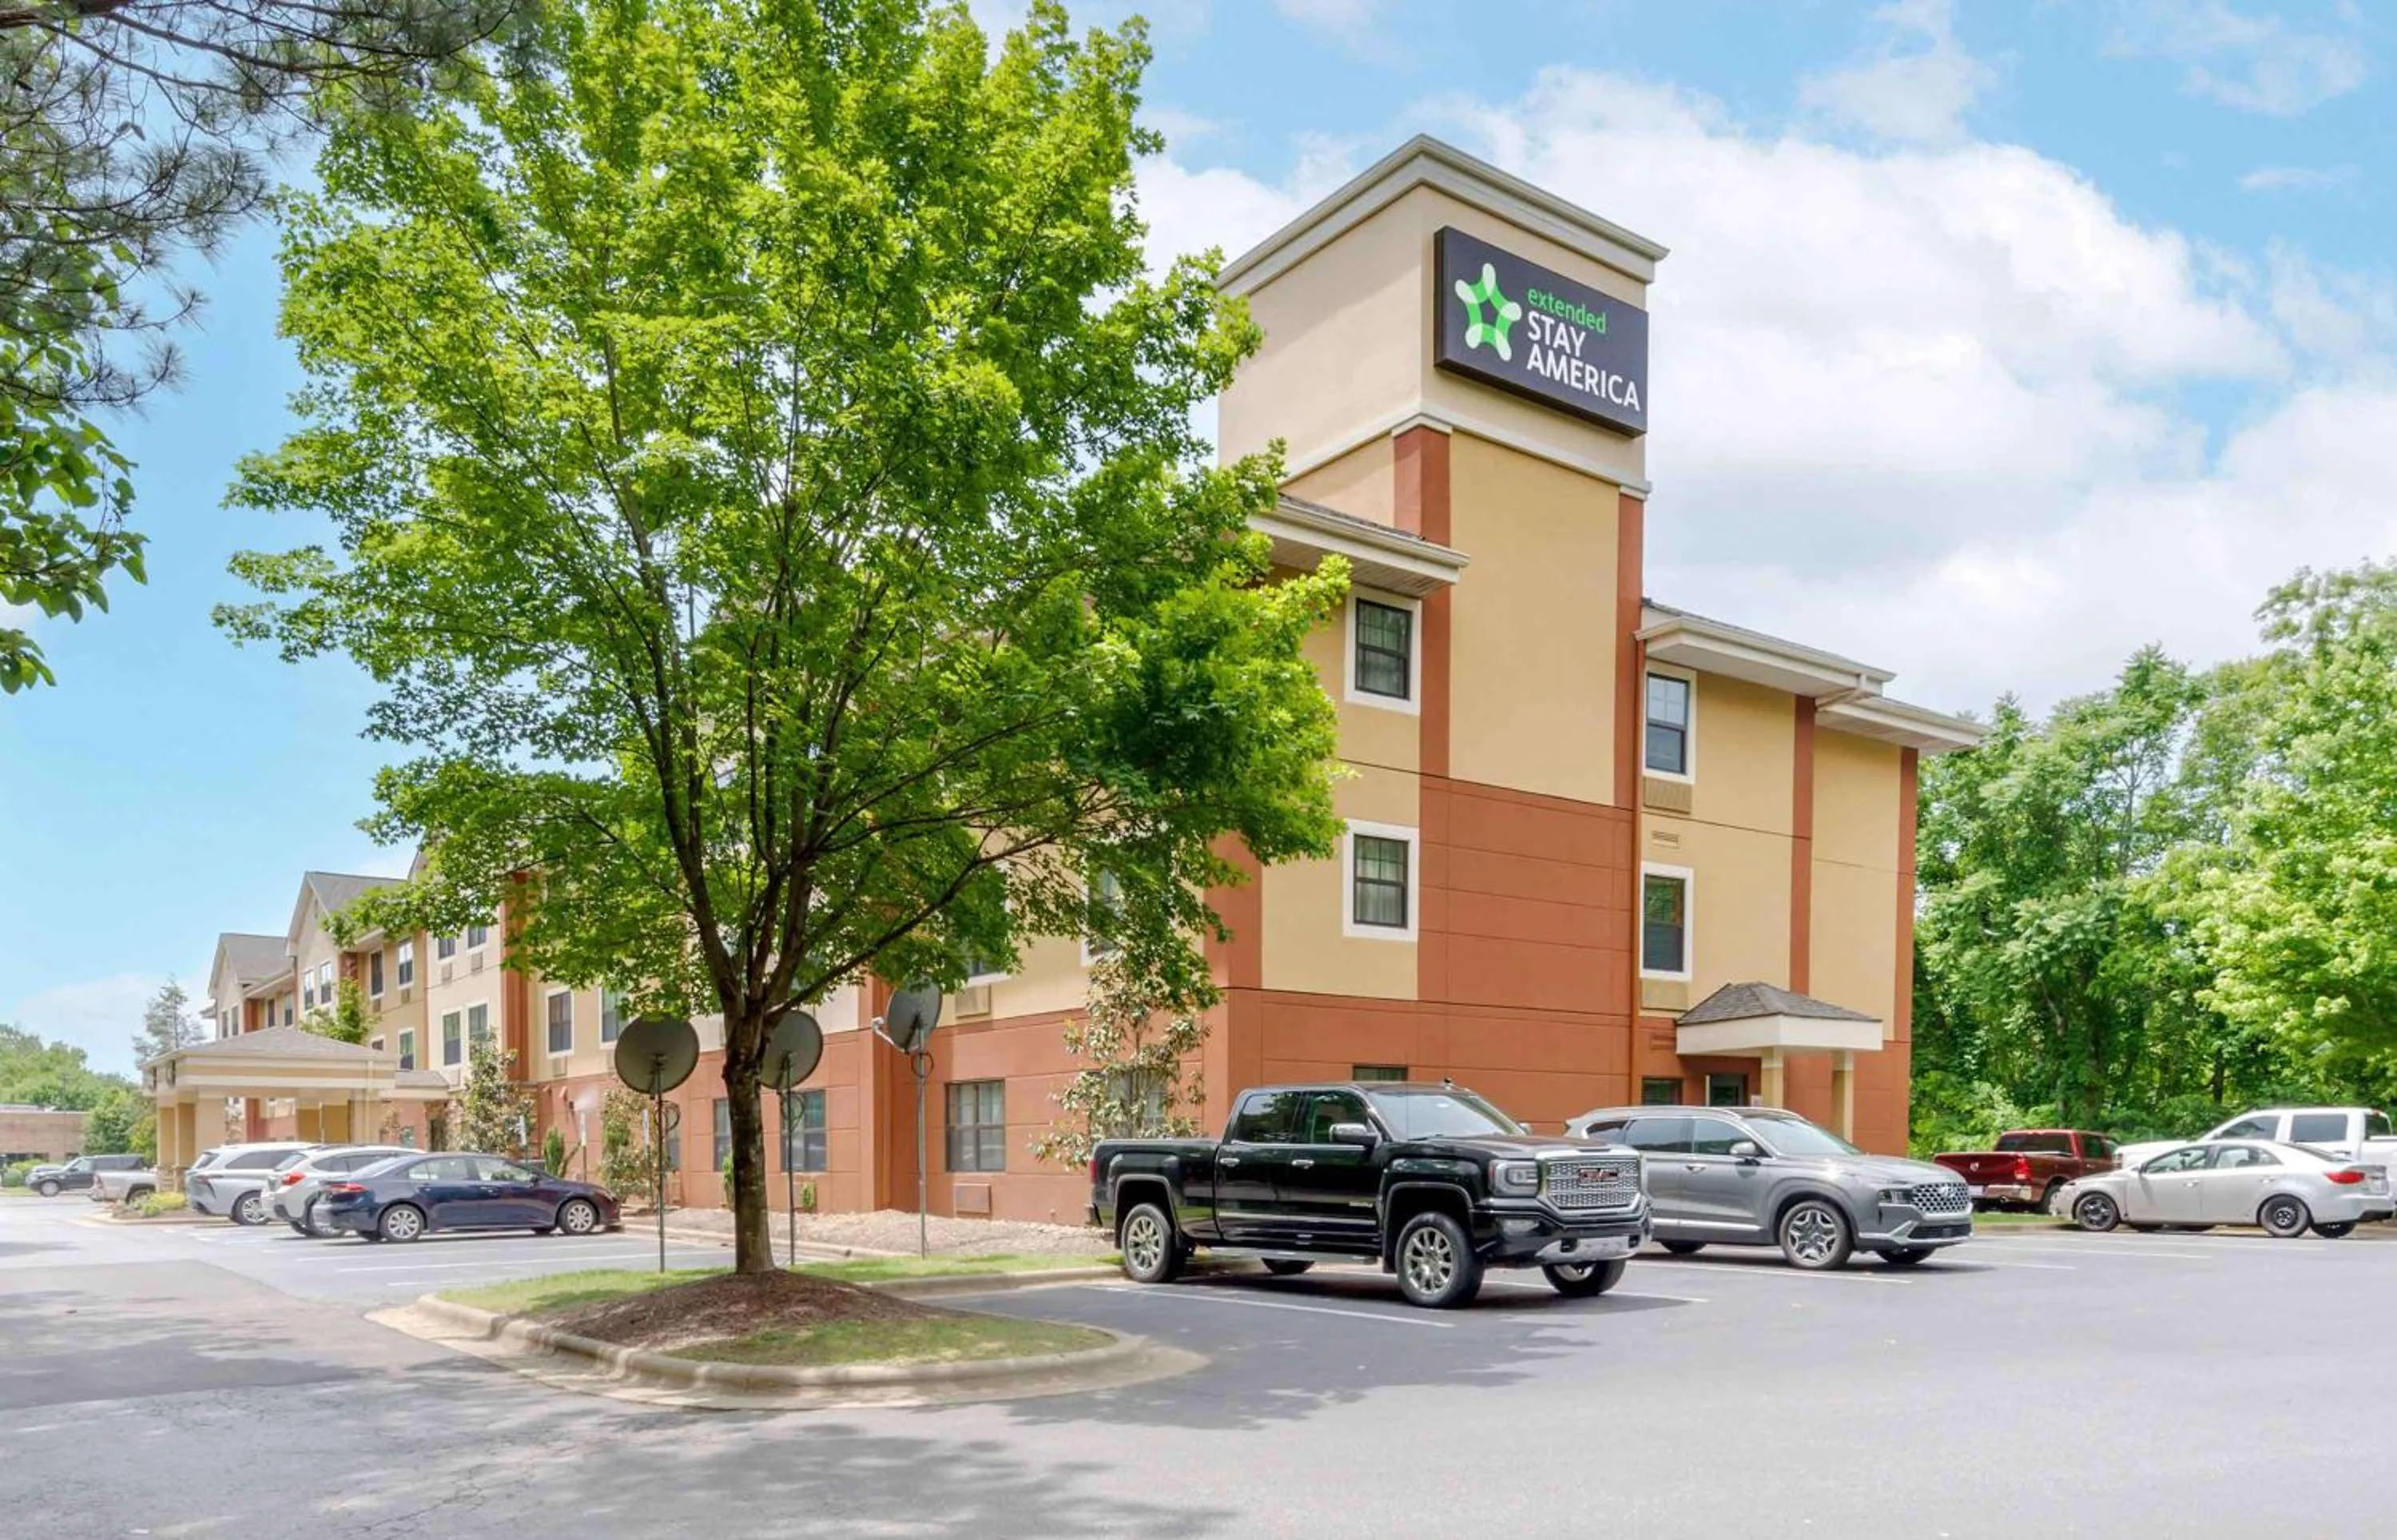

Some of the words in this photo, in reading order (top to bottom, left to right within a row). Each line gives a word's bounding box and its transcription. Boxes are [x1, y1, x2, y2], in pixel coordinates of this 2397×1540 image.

[1527, 288, 1607, 334] extended
[1527, 311, 1586, 357] STAY
[1526, 343, 1640, 411] AMERICA
